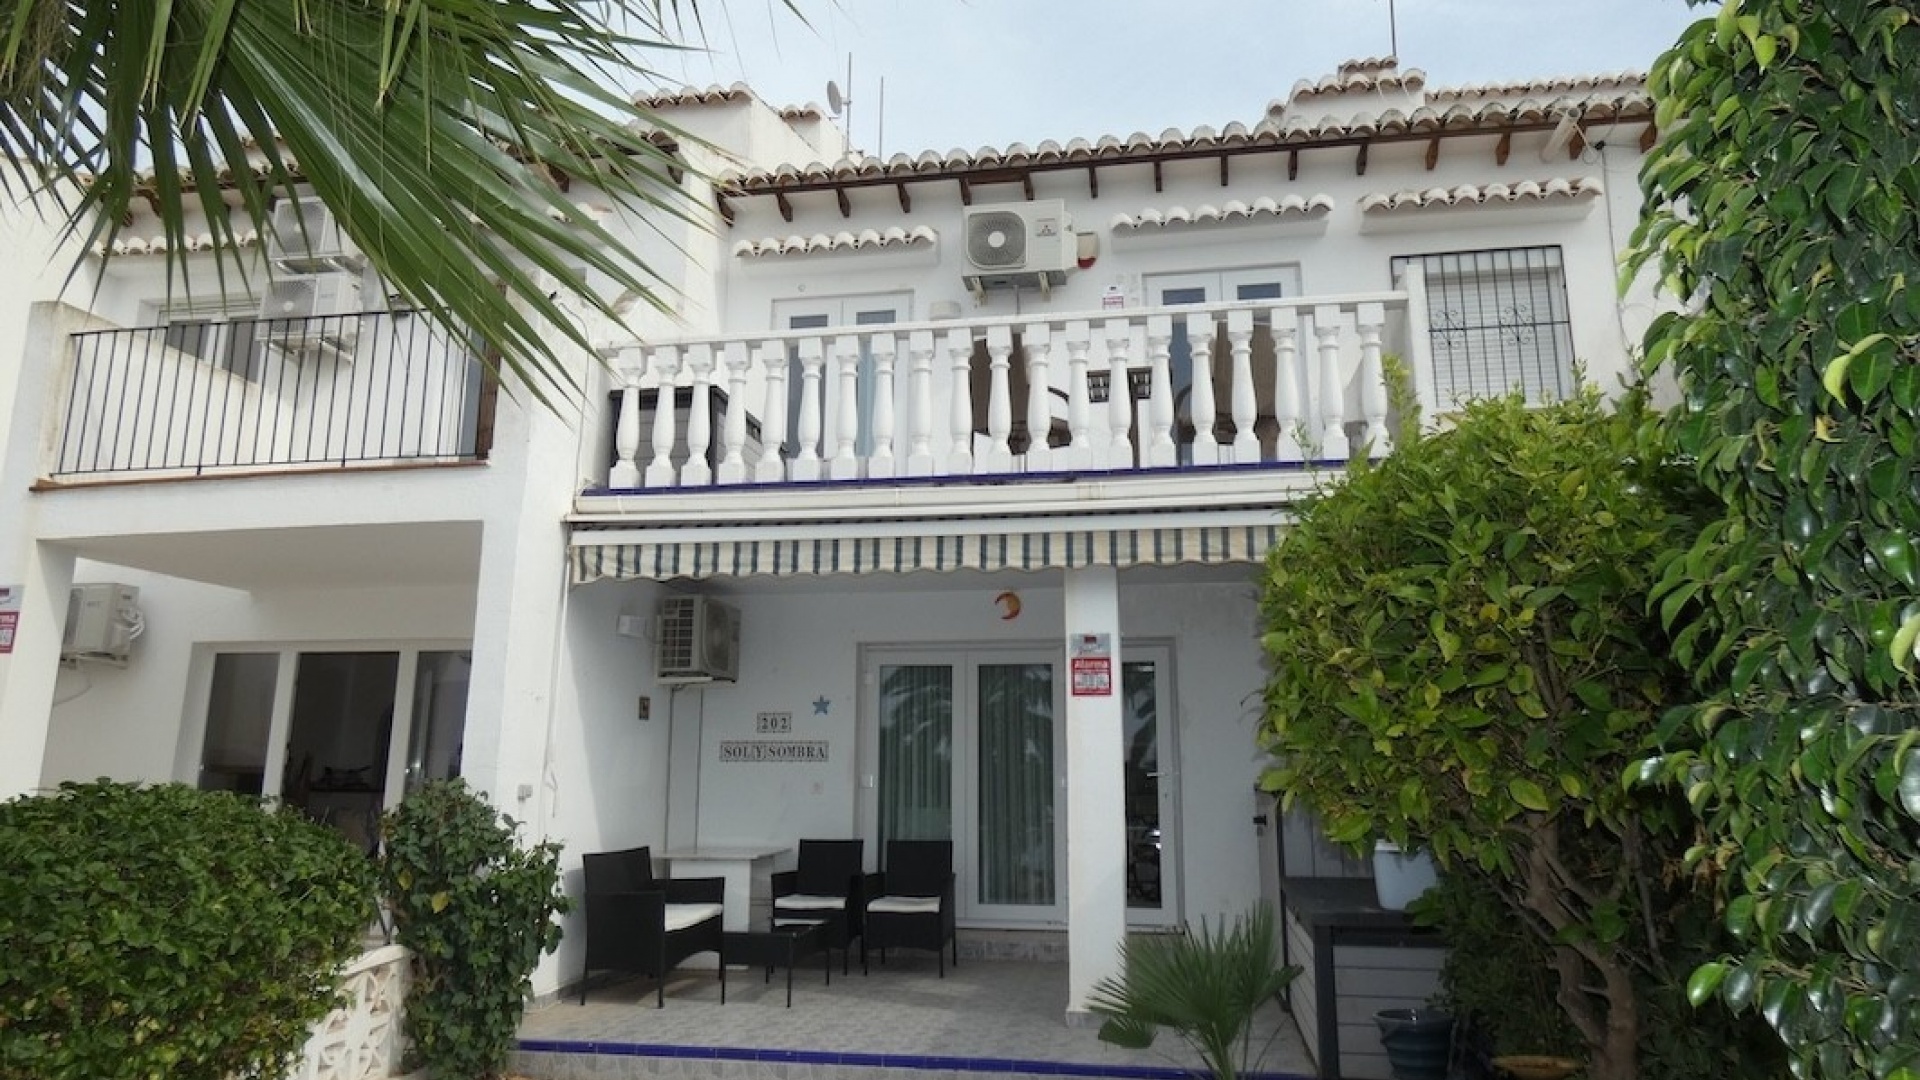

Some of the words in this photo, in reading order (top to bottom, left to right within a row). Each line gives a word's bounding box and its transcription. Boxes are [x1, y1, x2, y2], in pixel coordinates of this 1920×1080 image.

[760, 717, 788, 730] 202
[723, 744, 750, 759] SOL
[768, 744, 826, 759] SOMBRA
